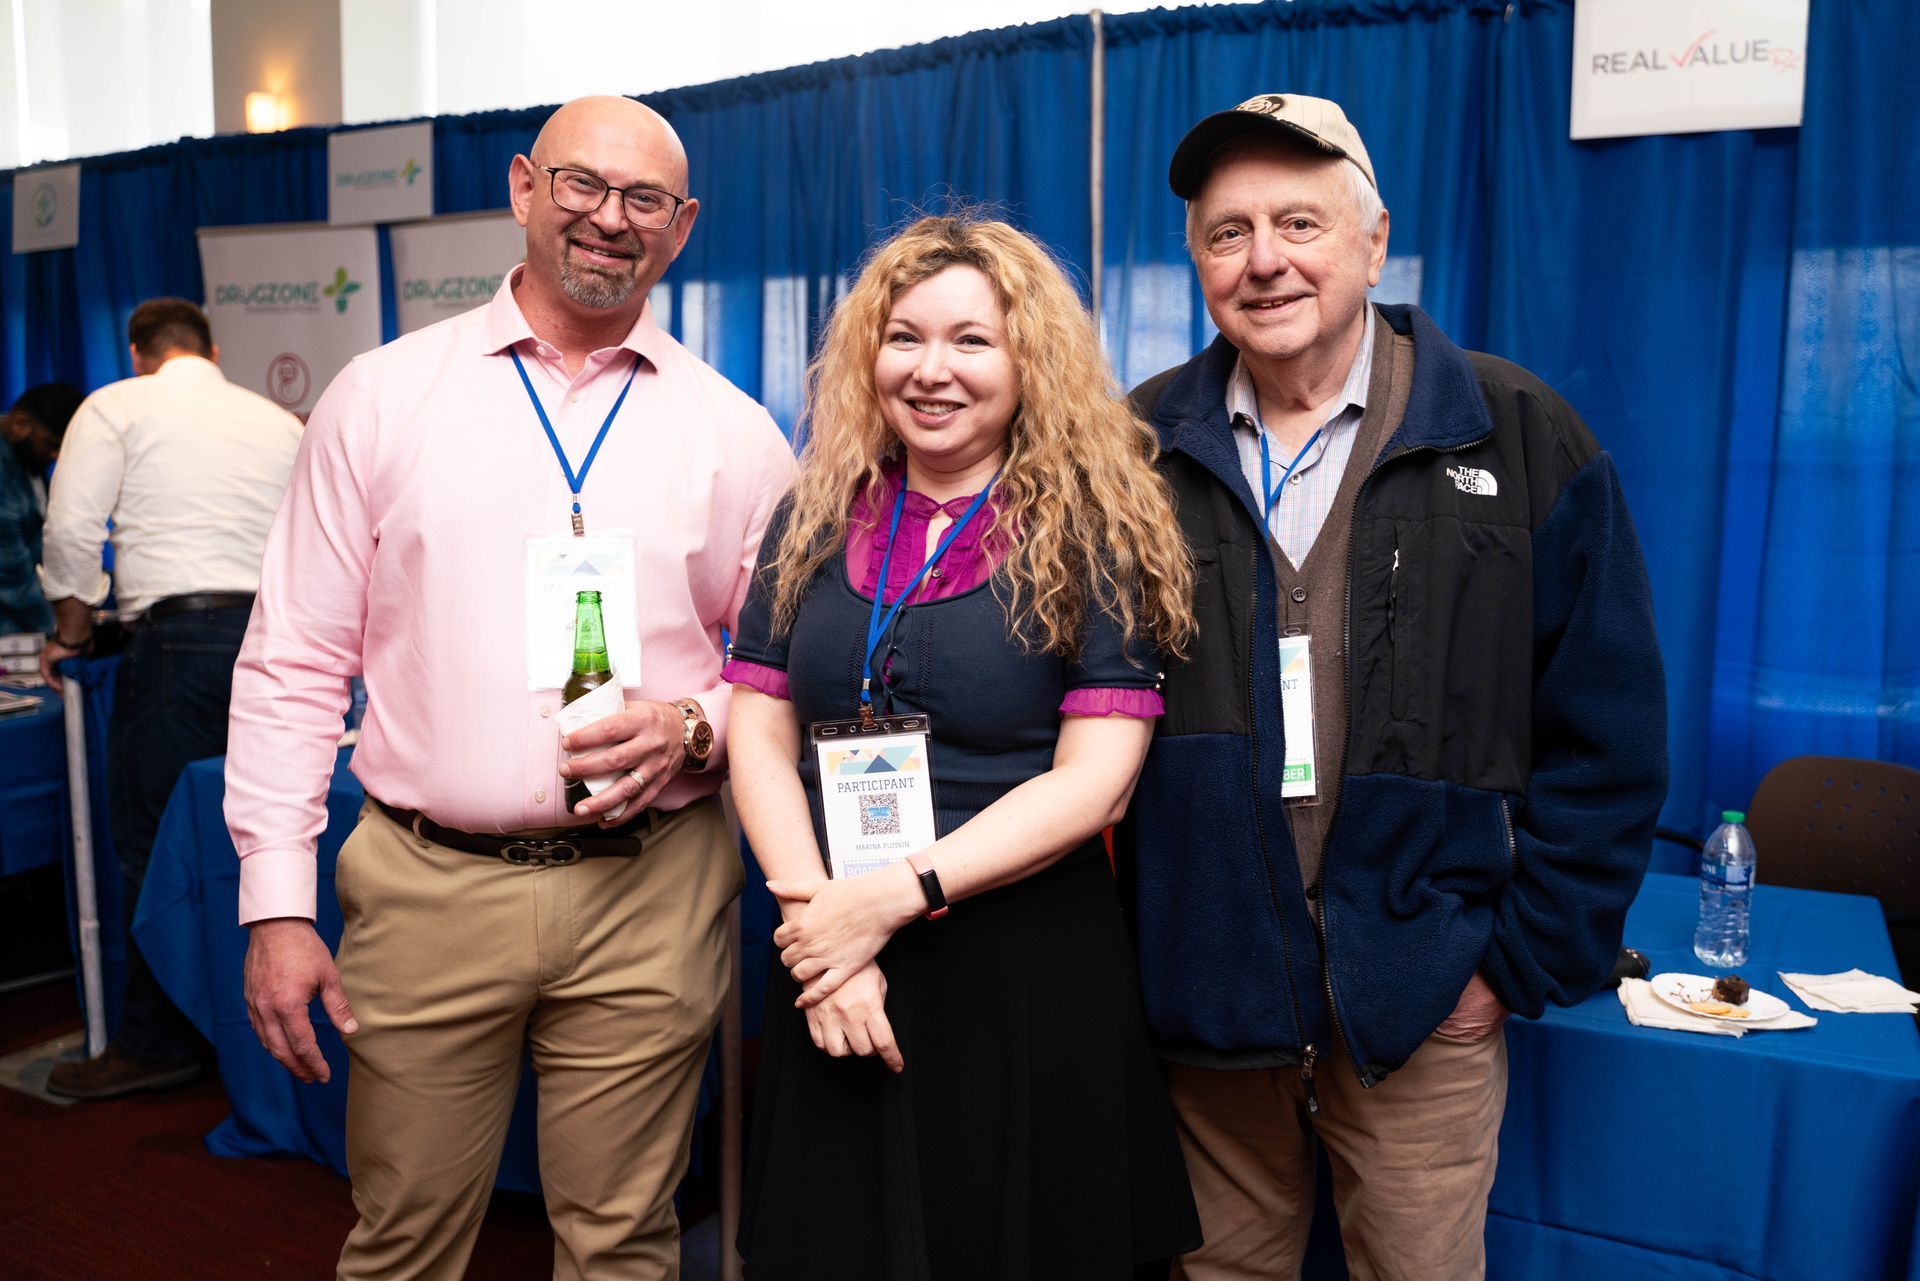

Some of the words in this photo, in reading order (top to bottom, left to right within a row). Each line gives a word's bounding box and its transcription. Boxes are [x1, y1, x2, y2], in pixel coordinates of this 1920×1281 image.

[1591, 49, 1668, 75] REAL
[1446, 467, 1478, 487] NORTH
[1457, 465, 1480, 478] THE
[1454, 479, 1478, 495] FACE
[1282, 679, 1298, 690] NT
[1283, 768, 1305, 780] BER
[837, 777, 915, 793] PARTICIPANT
[855, 843, 882, 851] MARINA
